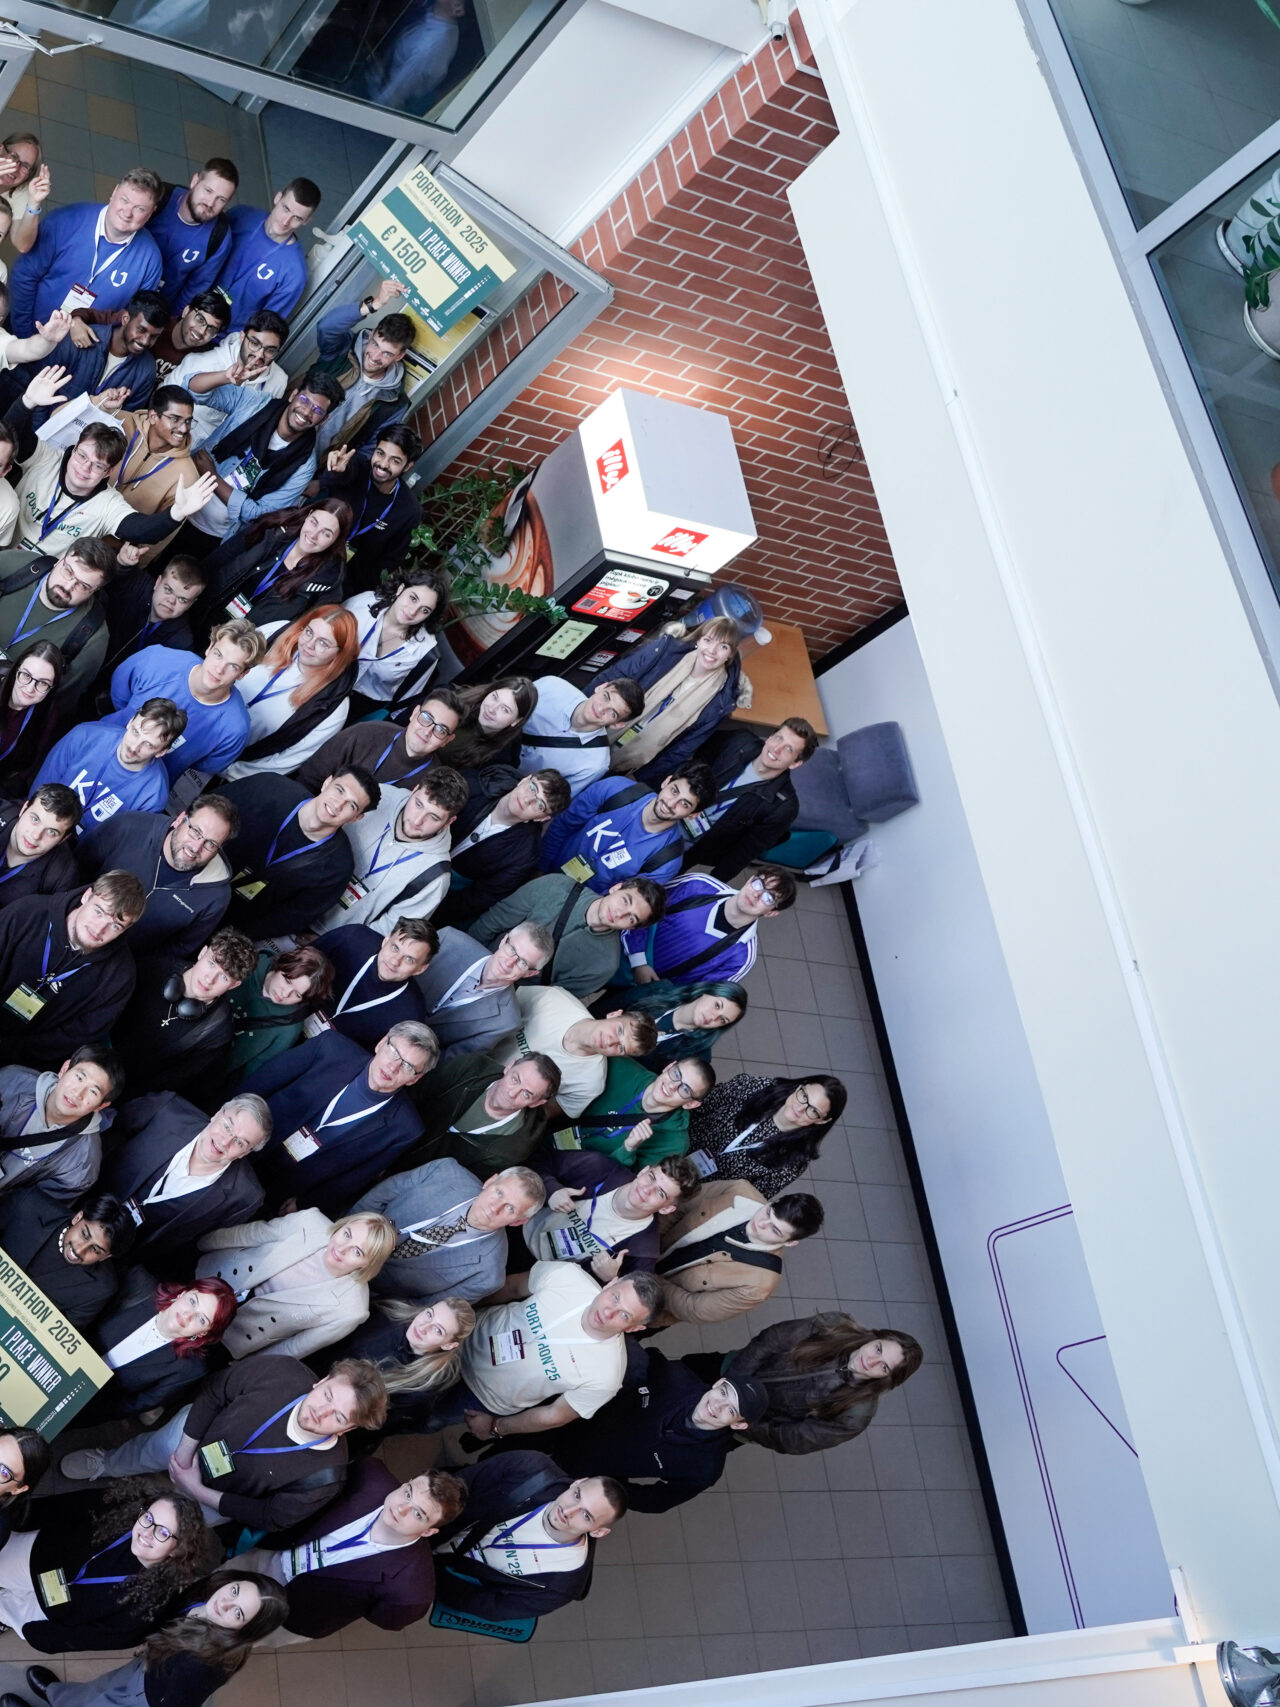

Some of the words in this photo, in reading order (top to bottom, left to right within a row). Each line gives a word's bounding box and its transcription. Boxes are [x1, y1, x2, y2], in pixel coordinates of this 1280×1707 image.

[411, 170, 464, 228] PORTATHON
[460, 225, 488, 254] 2025
[381, 225, 397, 242] €
[391, 237, 427, 275] 1500
[424, 233, 451, 261] PLACE
[441, 252, 471, 285] WINNER
[601, 449, 624, 490] illy
[657, 532, 698, 553] illy
[5, 1331, 32, 1364] PLACE
[27, 1354, 62, 1394] WINNER
[48, 1320, 82, 1355] 2025
